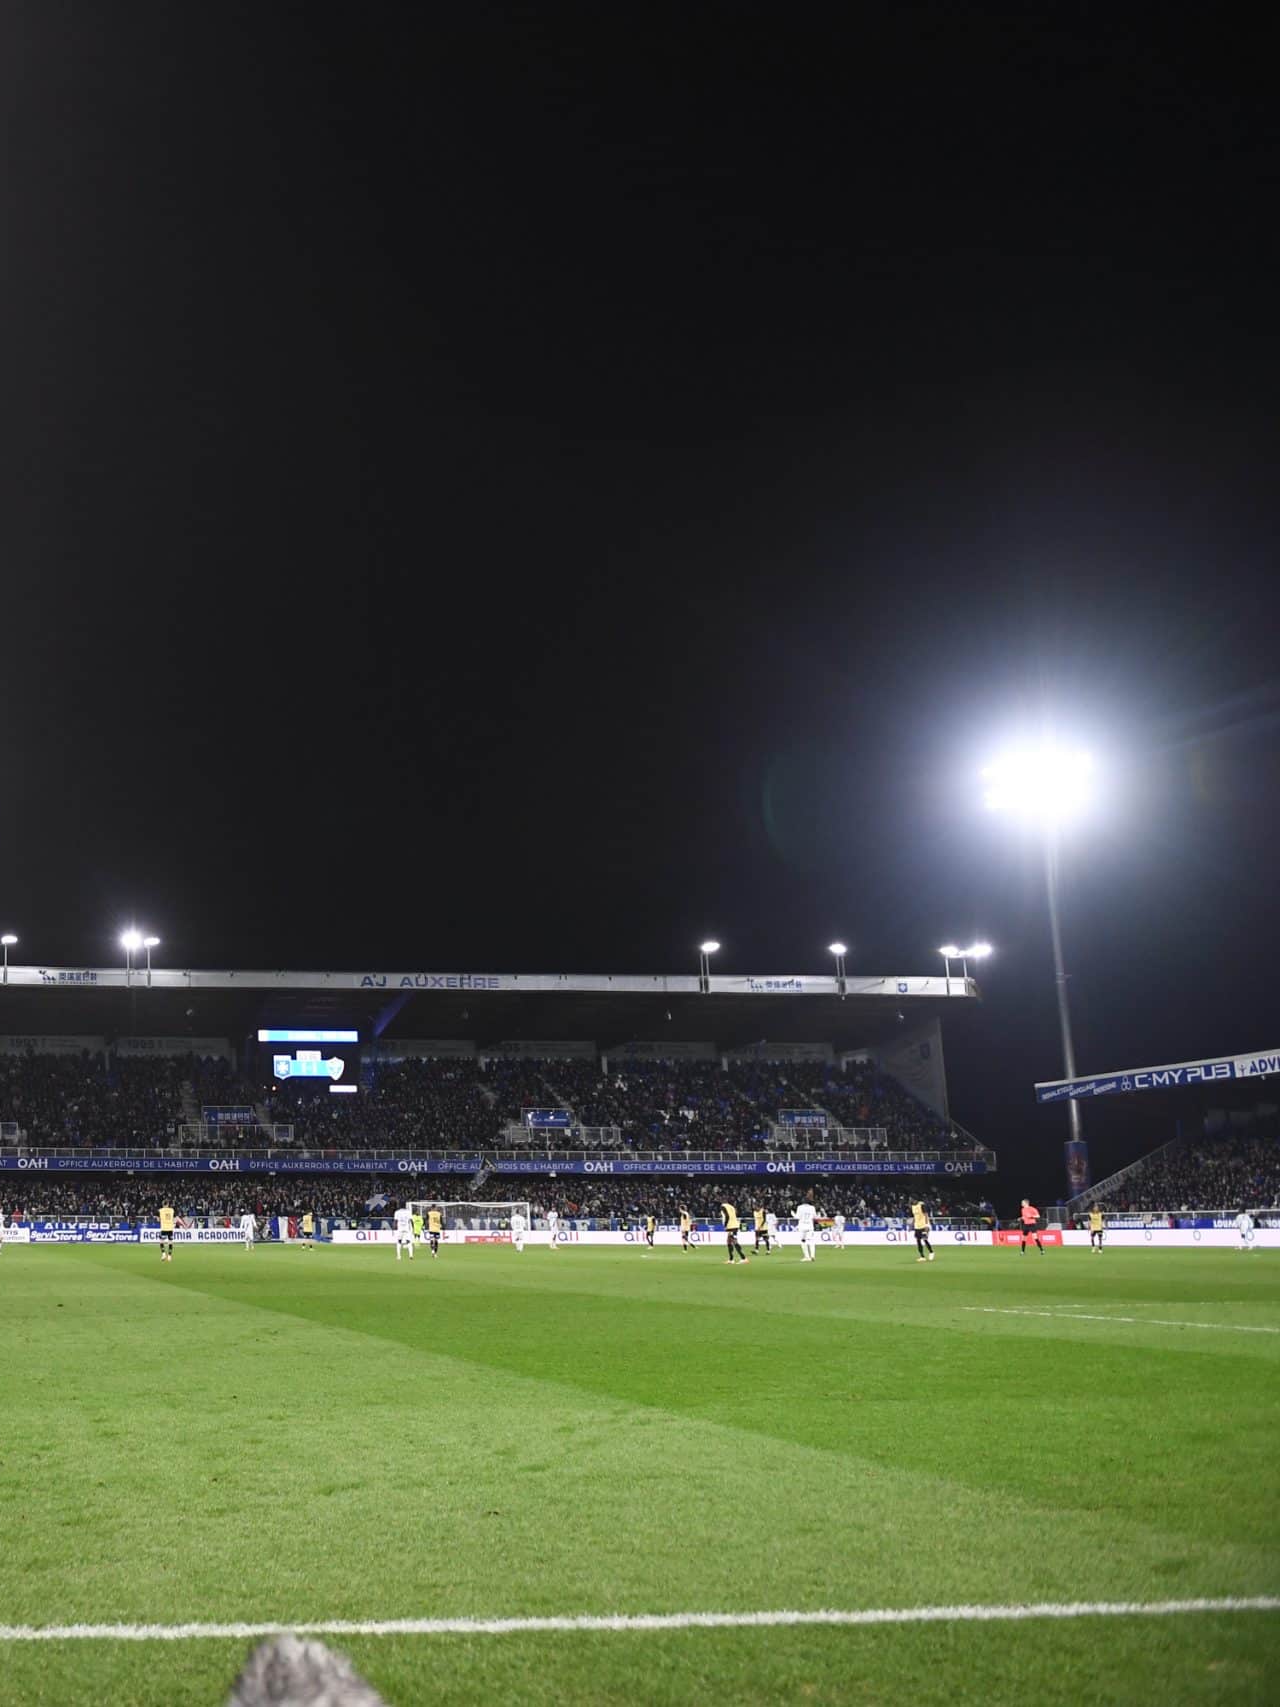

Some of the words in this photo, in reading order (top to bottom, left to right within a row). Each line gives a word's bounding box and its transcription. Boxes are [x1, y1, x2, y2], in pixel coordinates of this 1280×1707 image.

[360, 975, 387, 988] AJ
[400, 975, 500, 989] AUXERRE
[17, 1158, 48, 1169] OAH
[58, 1160, 89, 1168] OFFICE
[91, 1160, 141, 1168] AUXERROIS
[143, 1160, 155, 1168] DE
[209, 1159, 239, 1170] OAH
[249, 1161, 276, 1169] OFFICE
[281, 1161, 332, 1169] AUXERROIS
[398, 1160, 428, 1171] OAH
[438, 1162, 467, 1170] OFFICE
[519, 1162, 532, 1170] DE
[533, 1162, 574, 1170] L'HABITAT
[584, 1161, 613, 1172] OAH
[623, 1163, 652, 1171] OFFICE
[654, 1163, 702, 1171] AUXERROIS
[703, 1163, 715, 1171] DE
[717, 1163, 757, 1171] L'HABITAT
[766, 1162, 796, 1172] OAH
[804, 1163, 833, 1171] OFFICE
[835, 1163, 882, 1171] AUXERROIS
[883, 1163, 895, 1171] DE
[897, 1163, 936, 1171] L'HABITAT
[944, 1162, 973, 1172] OAH
